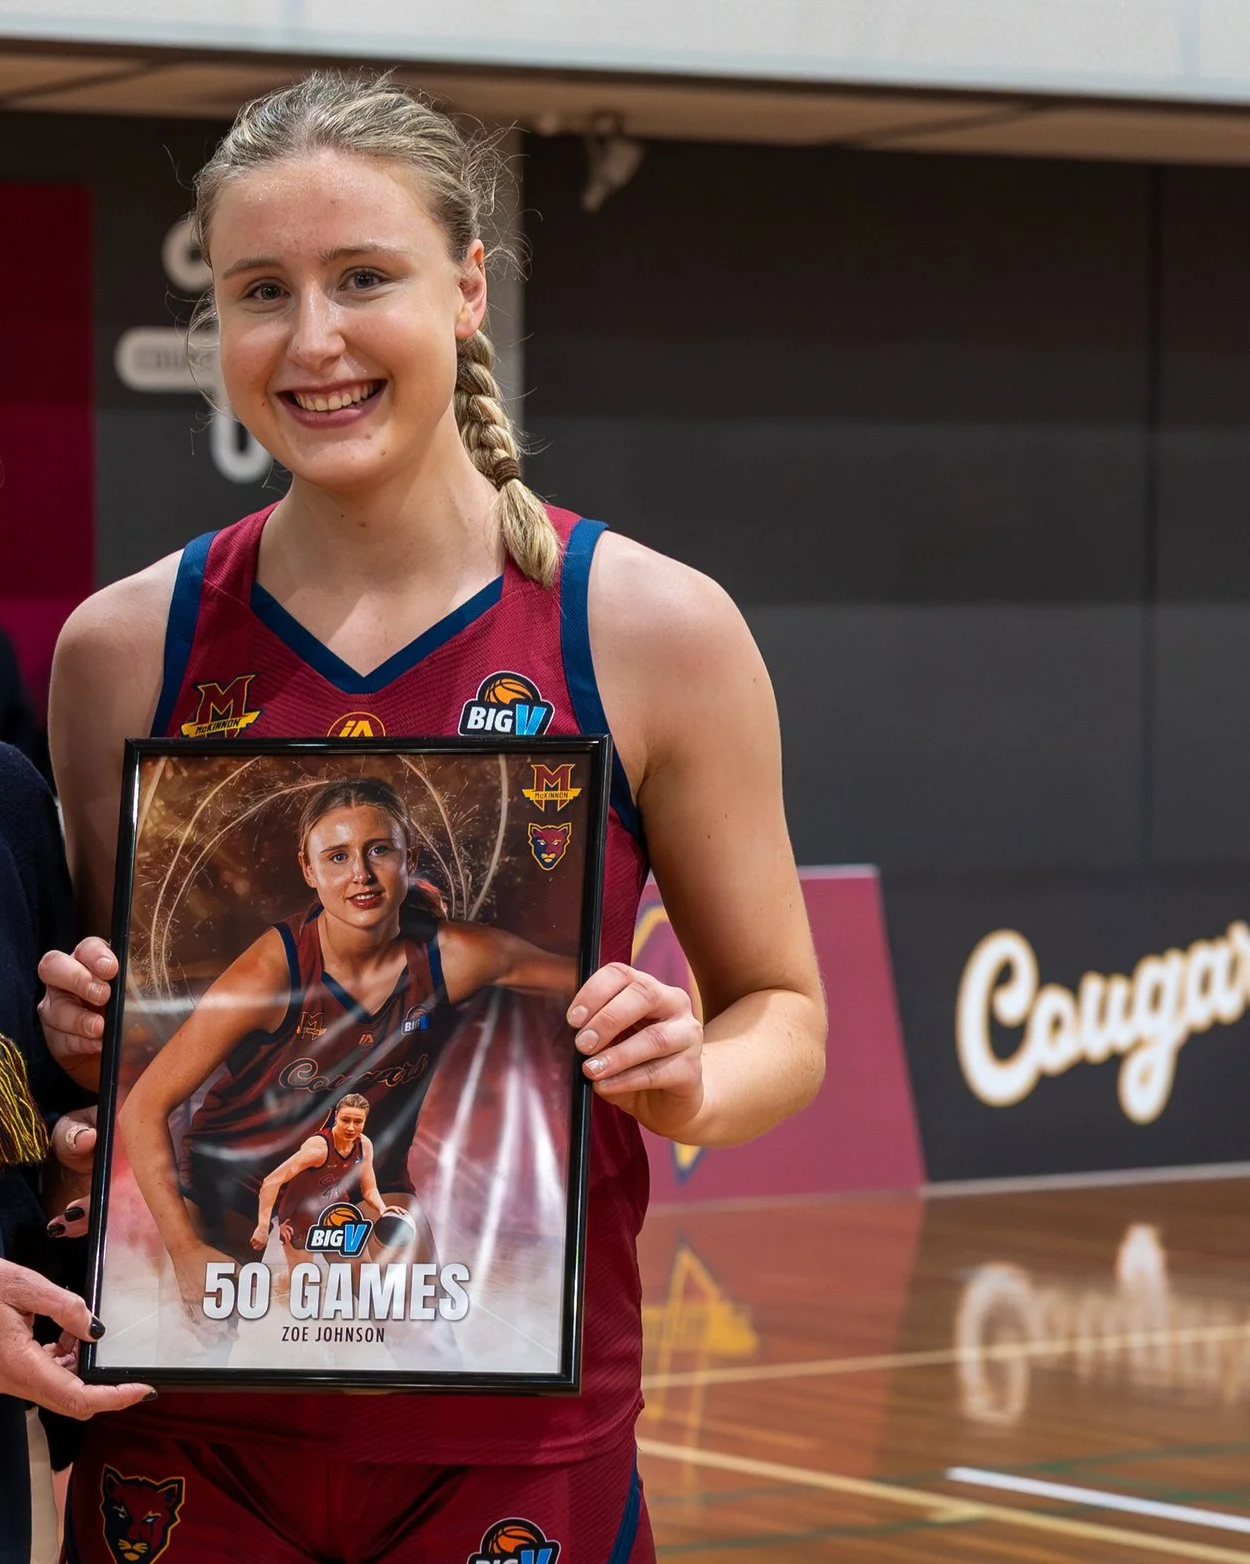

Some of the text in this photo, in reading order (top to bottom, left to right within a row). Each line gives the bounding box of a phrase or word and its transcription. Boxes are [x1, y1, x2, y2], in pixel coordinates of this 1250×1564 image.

[466, 705, 514, 733] BIG
[310, 1228, 344, 1248] BIG
[202, 1261, 471, 1322] 50 GAMES
[281, 1326, 386, 1343] ZOE JOHNSON
